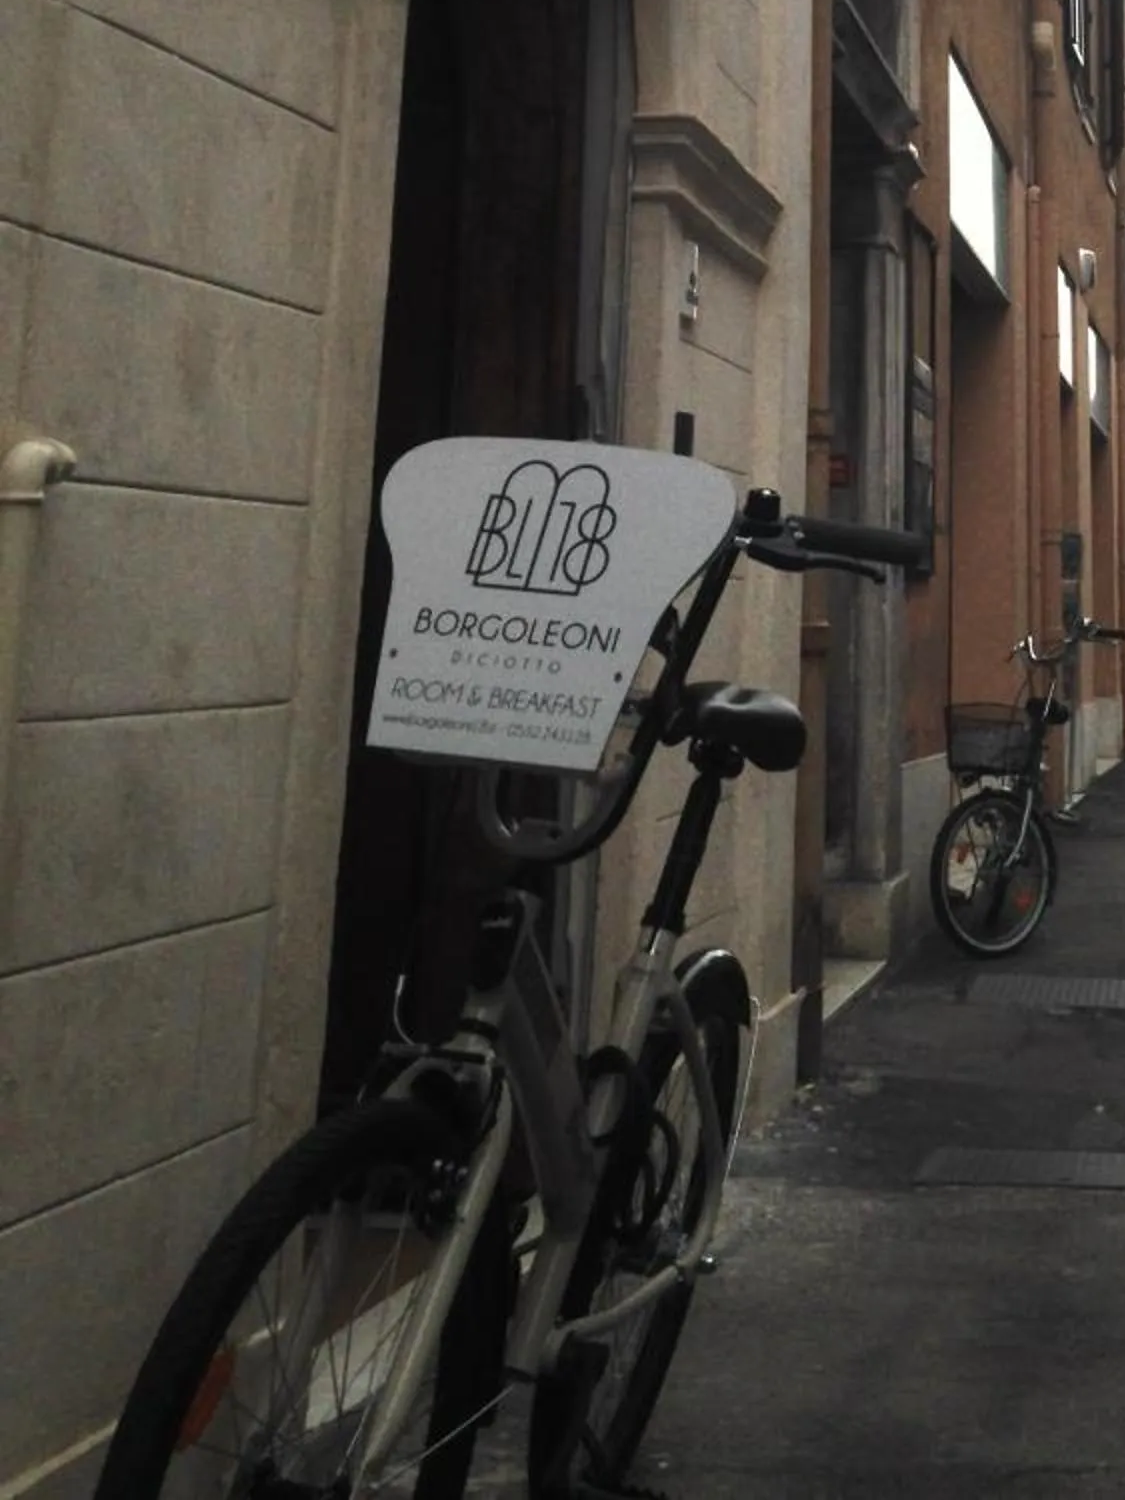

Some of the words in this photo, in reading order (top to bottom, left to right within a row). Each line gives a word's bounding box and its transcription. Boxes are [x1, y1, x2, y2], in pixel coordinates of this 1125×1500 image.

[413, 607, 622, 654] BORGOLEONI
[449, 651, 563, 675] DICIOTTO
[390, 676, 464, 703] ROOM
[466, 687, 484, 707] &
[486, 693, 602, 719] BREAKFAST
